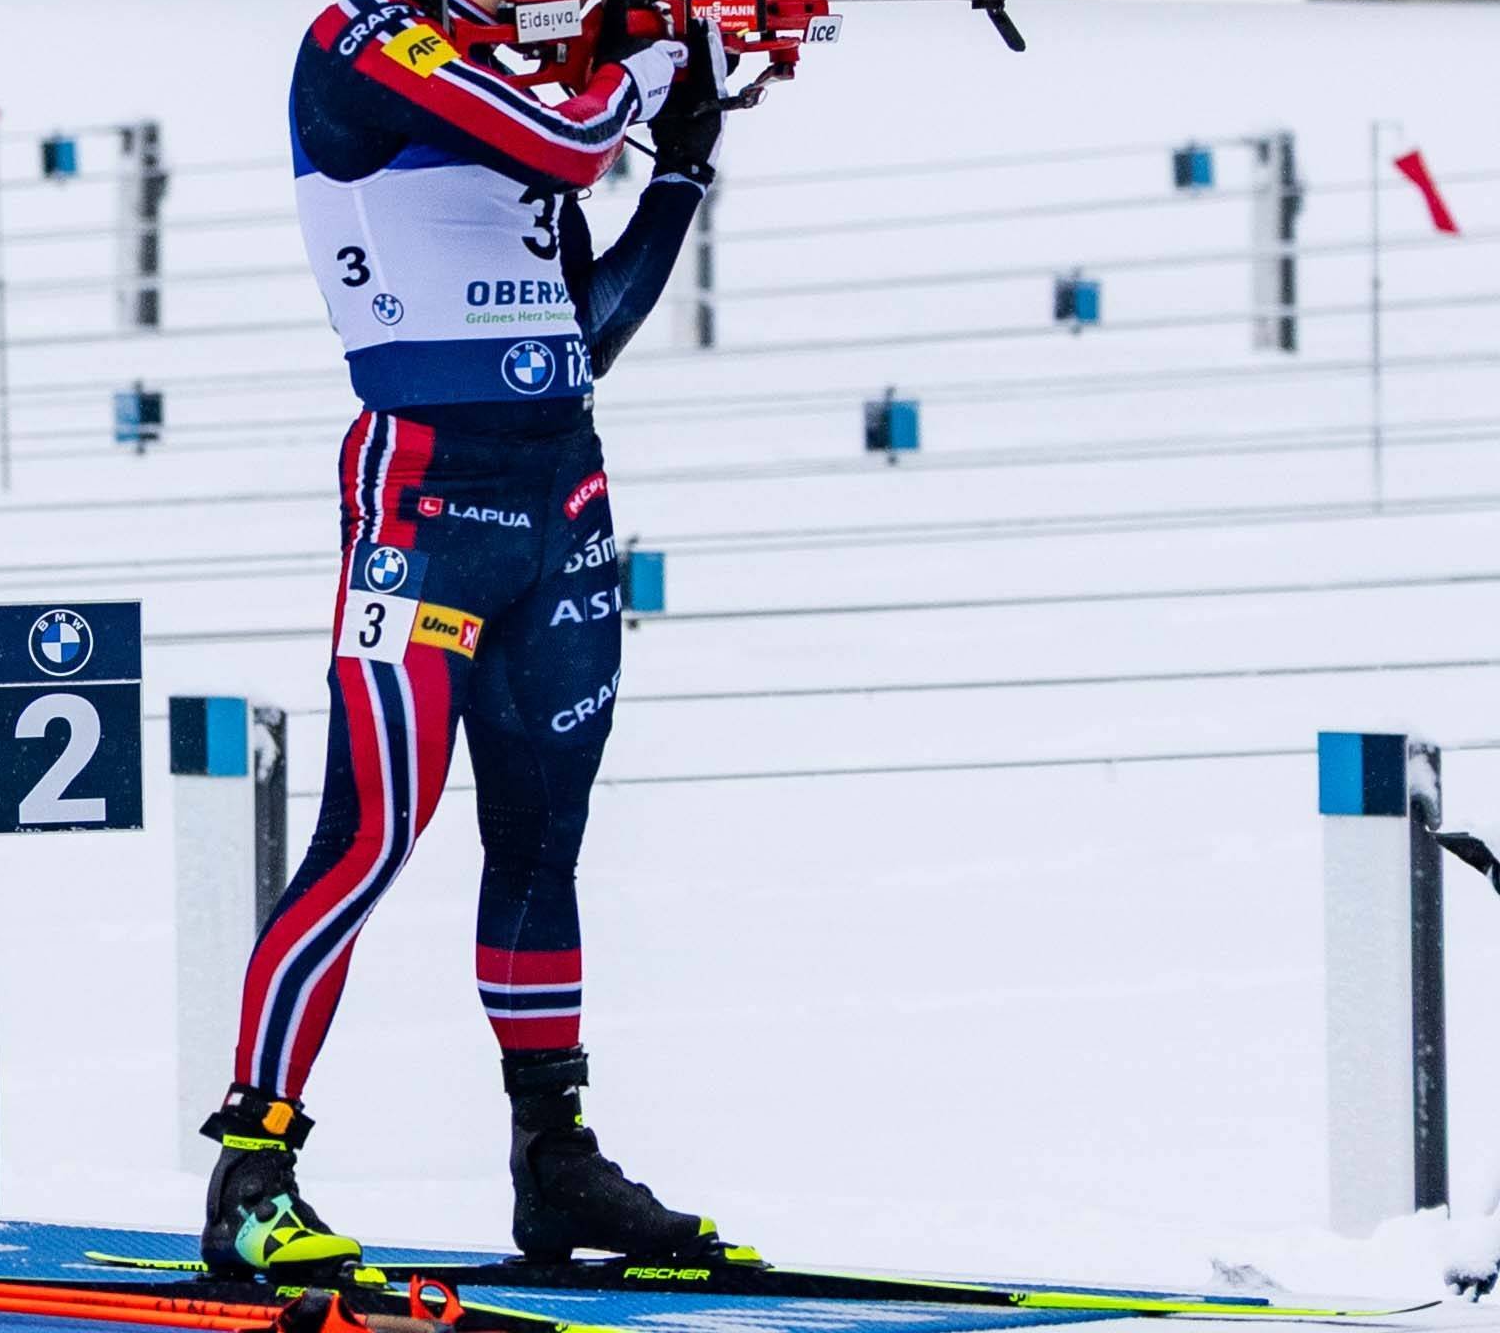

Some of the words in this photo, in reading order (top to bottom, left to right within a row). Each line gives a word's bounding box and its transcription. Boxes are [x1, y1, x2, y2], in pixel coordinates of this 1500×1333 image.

[339, 4, 410, 56] CRAFT
[810, 24, 836, 41] ice
[407, 35, 441, 65] AF
[337, 246, 370, 287] 3
[467, 280, 569, 307] OBERH
[466, 310, 514, 324] Grünes
[518, 310, 542, 322] Herz
[447, 503, 532, 528] LAPUA
[359, 603, 386, 648] 3
[551, 669, 620, 733] CRAF
[14, 693, 106, 824] 2
[623, 1267, 709, 1282] FISCHER
